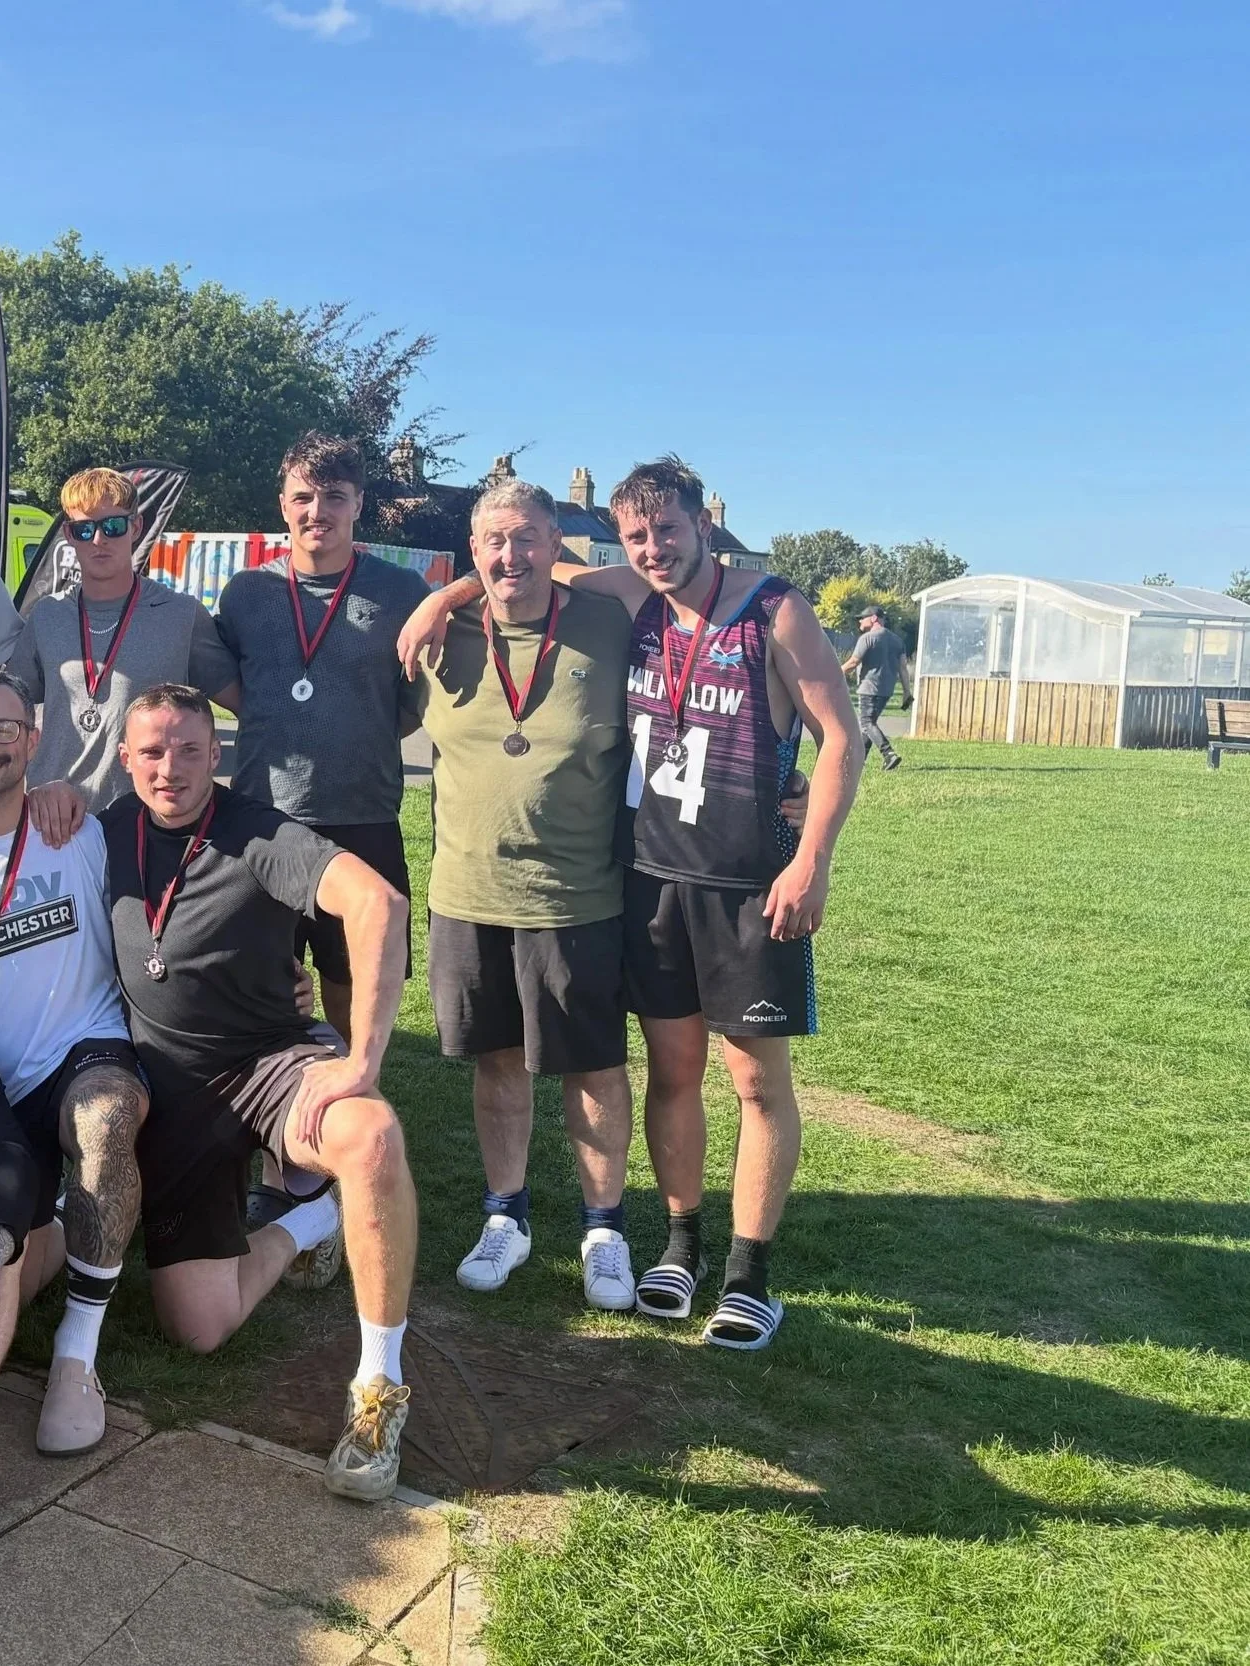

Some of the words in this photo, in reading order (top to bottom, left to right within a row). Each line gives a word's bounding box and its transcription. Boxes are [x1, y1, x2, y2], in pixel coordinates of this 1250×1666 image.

[627, 664, 744, 716] WILLOW
[626, 713, 710, 825] 14
[742, 1014, 788, 1023] PIONEER
